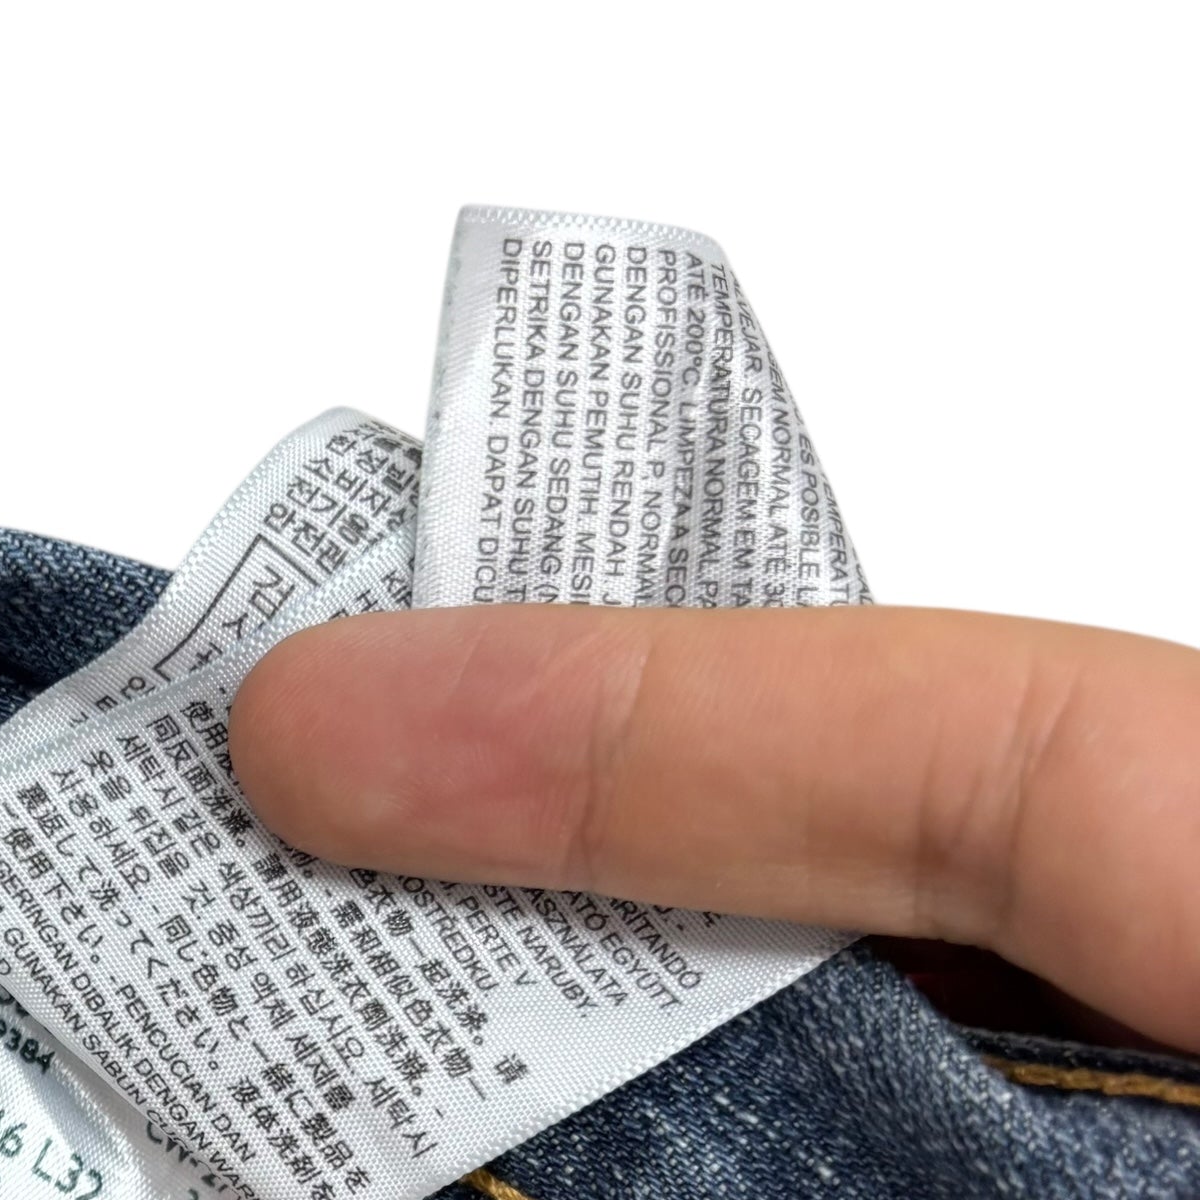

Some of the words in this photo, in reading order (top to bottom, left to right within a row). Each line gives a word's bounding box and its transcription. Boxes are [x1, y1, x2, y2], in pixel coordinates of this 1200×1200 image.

[525, 240, 552, 359] SETRIKA
[558, 241, 584, 360] DENGAN
[588, 243, 615, 381] GUNAKAN
[621, 246, 647, 363] DENGAN
[686, 252, 707, 300] ATÉ
[489, 238, 522, 426] DIPERLUKAN.
[646, 249, 676, 452] PROFISSIONAL
[707, 263, 730, 454] TEMPERATURA
[517, 368, 545, 488] DENGAN
[552, 369, 577, 448] SUHU
[576, 389, 608, 522] PEMUTIH.
[616, 371, 641, 450] SUHU
[672, 402, 698, 520] LIMPEZA
[734, 388, 762, 519] SECAGEM
[769, 407, 791, 517] NORMAL
[481, 434, 508, 525] DAPAT
[539, 458, 570, 575] SEDANG
[602, 461, 635, 584] RENDAH.
[672, 525, 691, 541] A
[800, 471, 820, 580] POSIBLE
[260, 497, 353, 577] 안전관
[472, 536, 498, 603] DICU
[508, 497, 535, 575] SUHU
[568, 531, 596, 604] MESI
[664, 548, 690, 608] SEC
[731, 530, 754, 575] EM
[730, 581, 751, 609] TA
[46, 761, 160, 906] 사용하세요.
[77, 744, 135, 808] 옷을
[119, 800, 192, 886] 뒤집을
[178, 879, 220, 922] 것.
[203, 916, 259, 977] 중성
[240, 967, 297, 1033] 액체
[207, 856, 298, 965] 색상끼리
[397, 866, 502, 998] OSTŘEDKU.
[455, 892, 520, 974] PERTE
[513, 970, 537, 993] V
[481, 878, 524, 926] STE
[559, 880, 612, 934] ATÓ
[522, 880, 630, 1008] ASZNÁLATA
[66, 968, 145, 1062] DIBALIK
[130, 1053, 213, 1152] DENGAN
[78, 1030, 150, 1111] SABUN
[209, 1110, 260, 1167] DAN
